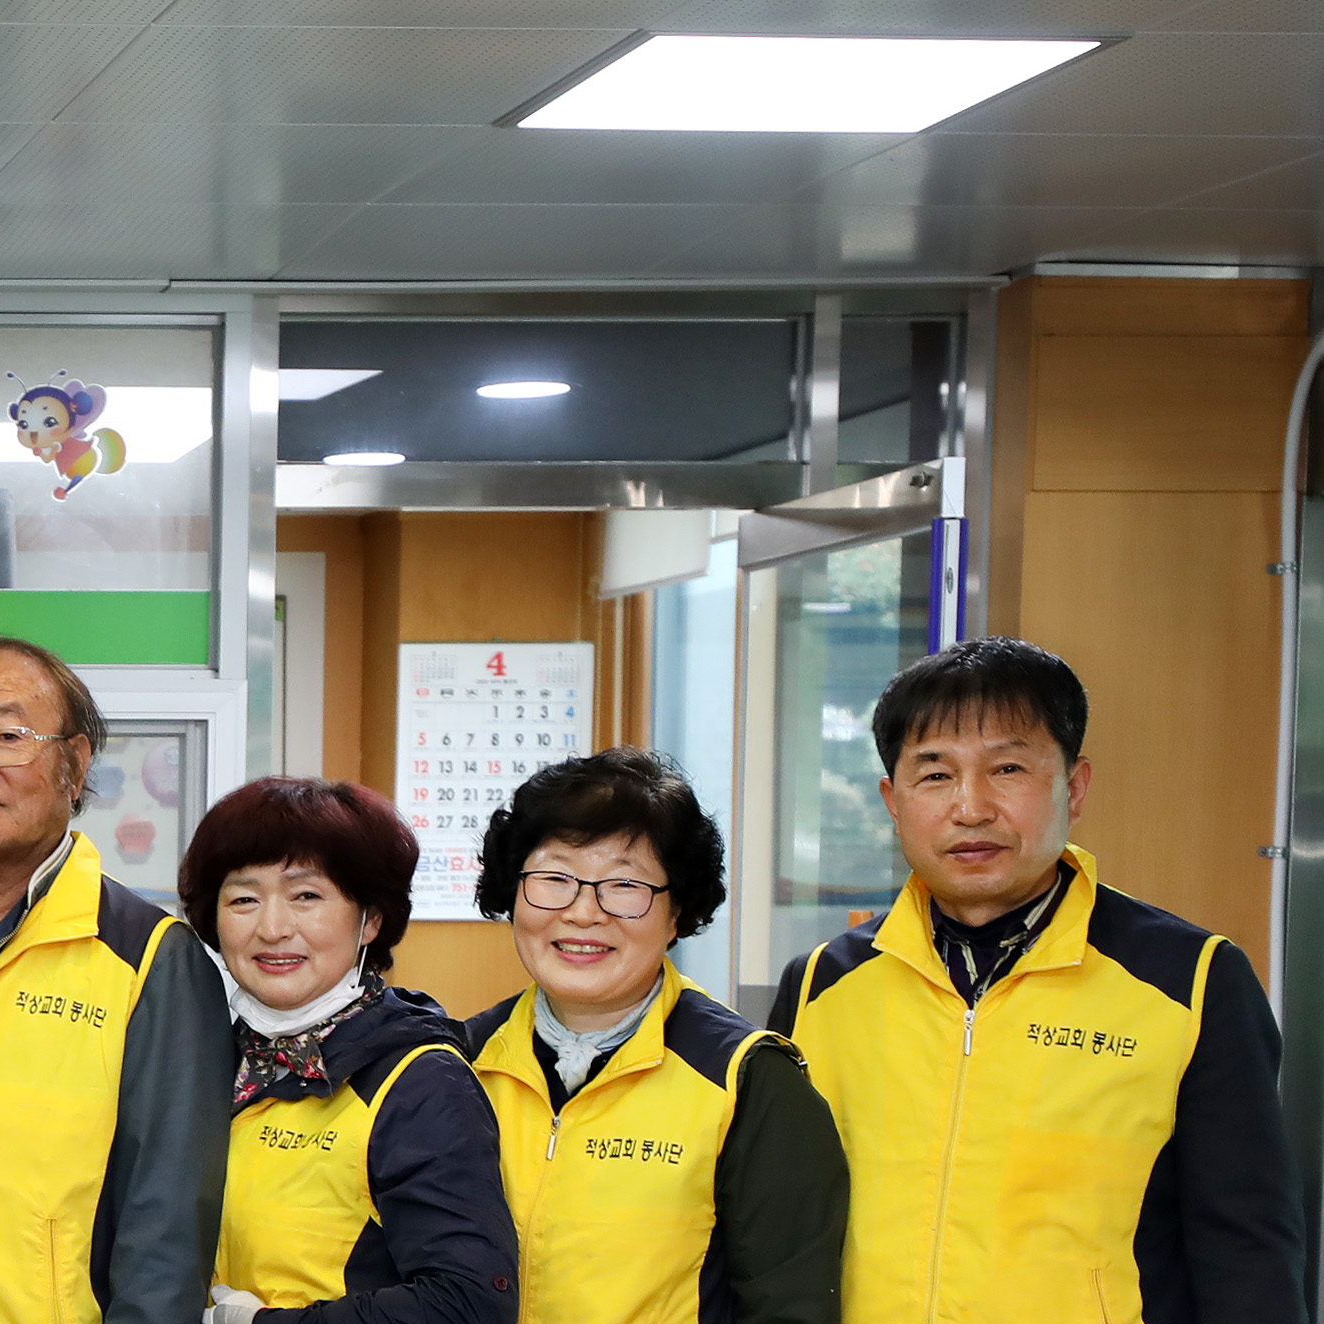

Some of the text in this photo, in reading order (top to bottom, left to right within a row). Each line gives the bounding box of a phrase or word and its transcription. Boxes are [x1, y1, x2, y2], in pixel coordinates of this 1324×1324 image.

[486, 651, 507, 676] 4
[493, 706, 575, 718] 1 2 3 4
[418, 734, 576, 746] 5 6 7 8 9 10 11
[414, 761, 430, 774] 12
[439, 761, 453, 774] 13
[464, 761, 478, 774] 14
[487, 761, 501, 774] 15
[512, 761, 526, 774] 16
[413, 788, 503, 801] 19 20 21 22
[412, 815, 478, 828] 26 27 28
[16, 991, 107, 1028] 적상교회 봉사단
[1027, 1023, 1138, 1057] 적상교회 봉사단
[586, 1138, 684, 1164] 적상교회 봉사단
